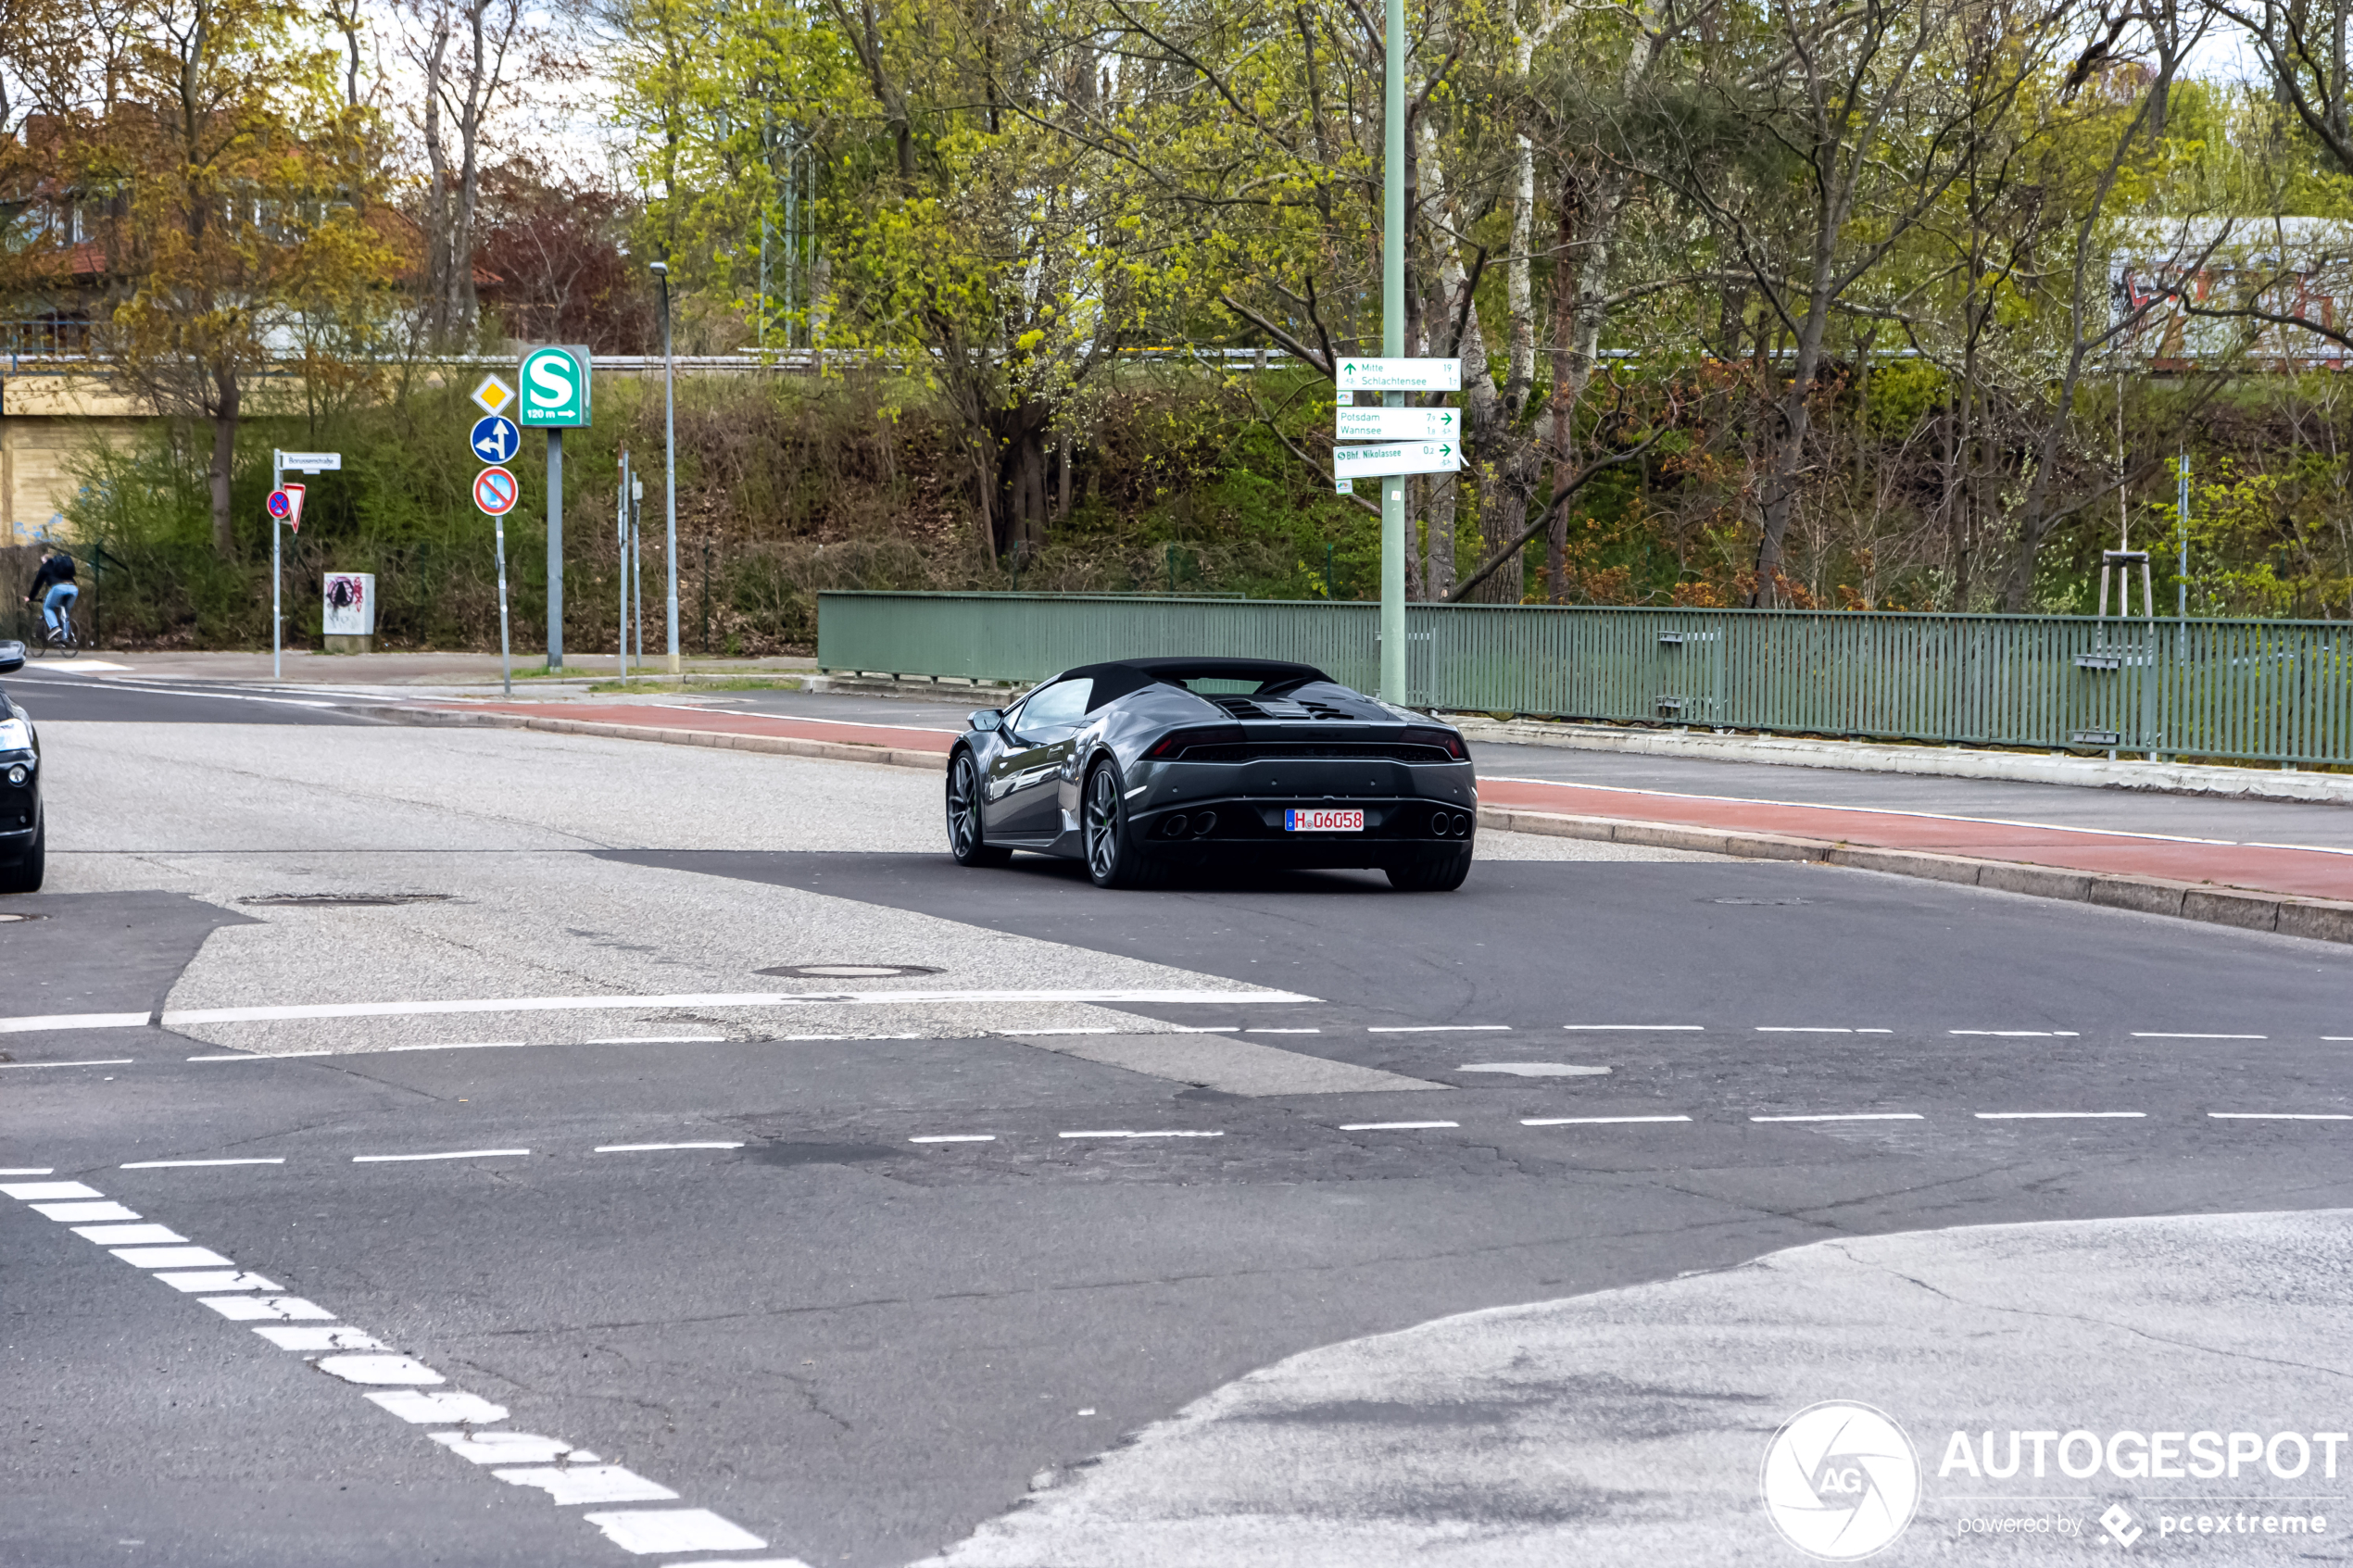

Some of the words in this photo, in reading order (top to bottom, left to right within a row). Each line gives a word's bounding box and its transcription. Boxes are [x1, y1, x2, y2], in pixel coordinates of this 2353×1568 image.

[1361, 363, 1383, 372] Mitte
[1443, 363, 1452, 372] 19
[530, 355, 573, 408] S
[1361, 376, 1427, 385] Schlachtensee
[527, 408, 545, 419] 120
[545, 410, 556, 419] m
[1340, 412, 1380, 421] Potsdam
[1340, 425, 1382, 434] Wannsee
[1346, 450, 1361, 460] Bhf.
[1363, 449, 1402, 459] Nikolassee
